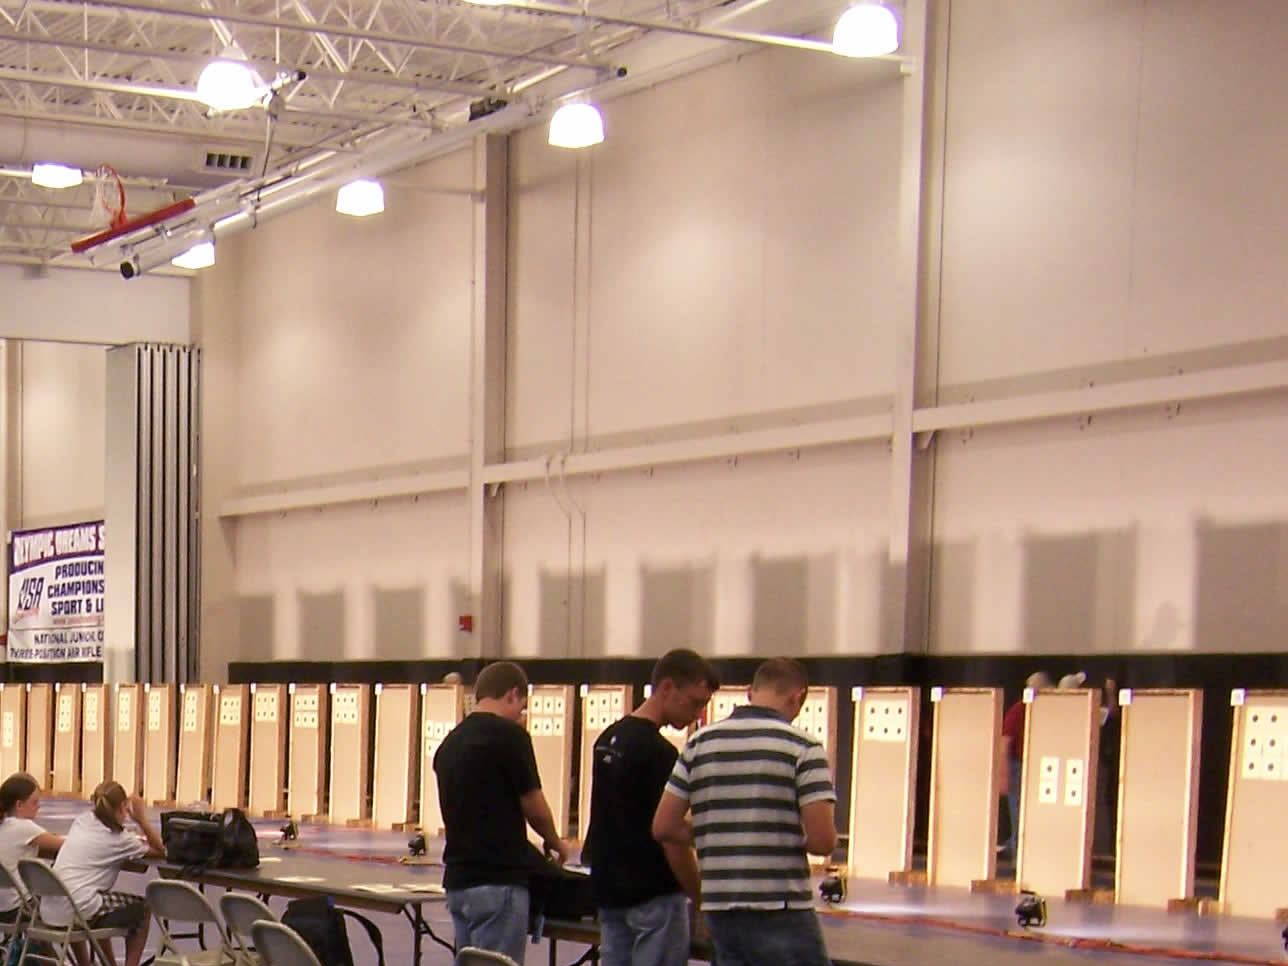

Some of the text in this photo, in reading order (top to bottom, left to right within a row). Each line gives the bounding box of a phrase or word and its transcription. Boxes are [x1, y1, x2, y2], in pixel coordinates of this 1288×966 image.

[47, 579, 104, 599] CHAMPIONS
[51, 599, 82, 616] SPORT
[33, 631, 68, 645] NATIONAL
